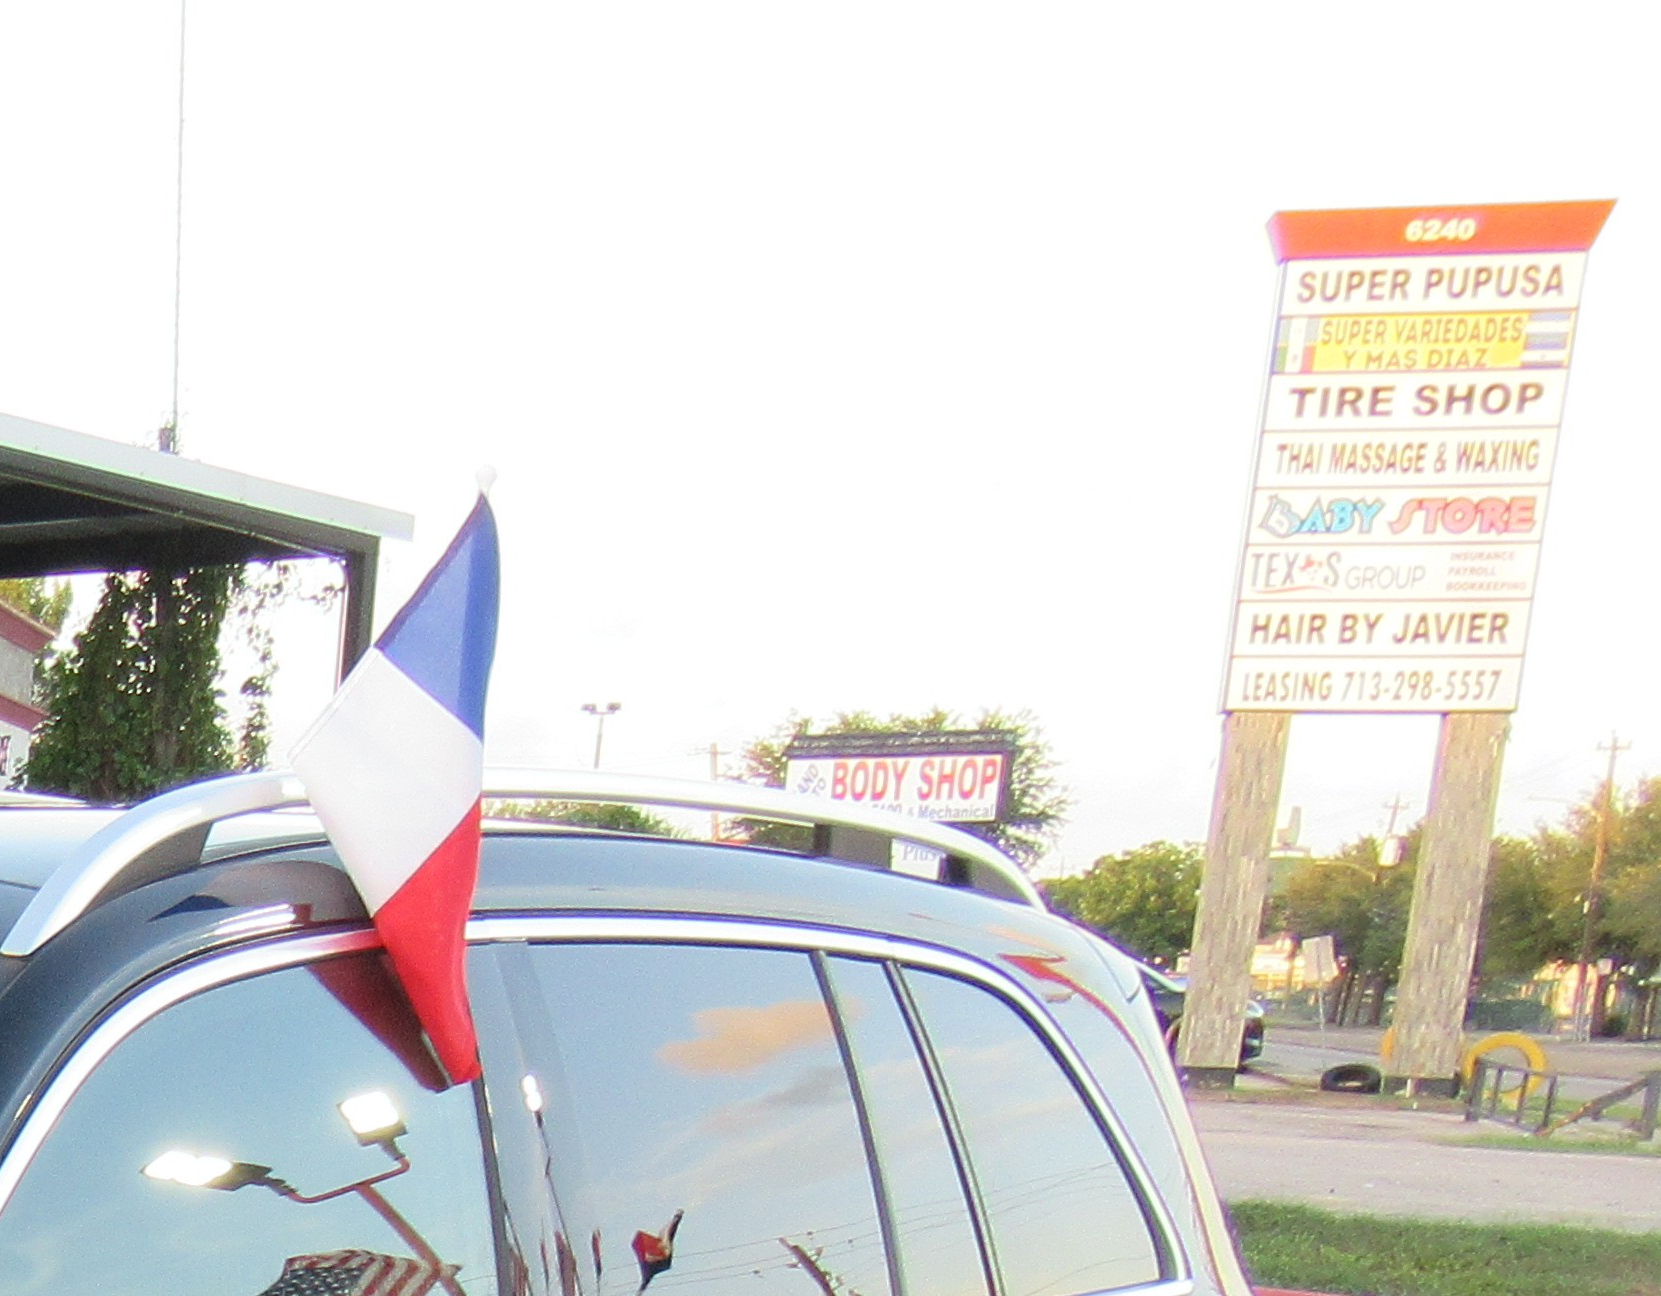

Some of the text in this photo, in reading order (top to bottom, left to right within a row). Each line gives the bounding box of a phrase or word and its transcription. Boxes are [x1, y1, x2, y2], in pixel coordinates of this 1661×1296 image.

[1405, 218, 1476, 241] 6240
[1296, 264, 1565, 304] SUPER PUPUSA
[1321, 315, 1524, 346] SUPER VARIEDADES
[1343, 347, 1490, 370] Y MAS DIAZ
[1288, 381, 1544, 418] TIRE SHOP
[1276, 439, 1540, 475] THAI MASSAGE & WAXING
[1257, 494, 1538, 538] BABY STORE
[1344, 565, 1427, 590] GROUP
[1448, 567, 1497, 577] PAYROLL
[1249, 612, 1510, 644] HAIR BY JAVIER
[1242, 669, 1503, 702] LEASING 713-298-5557
[830, 756, 999, 801] BODY SHOP
[917, 803, 995, 821] Mechanical
